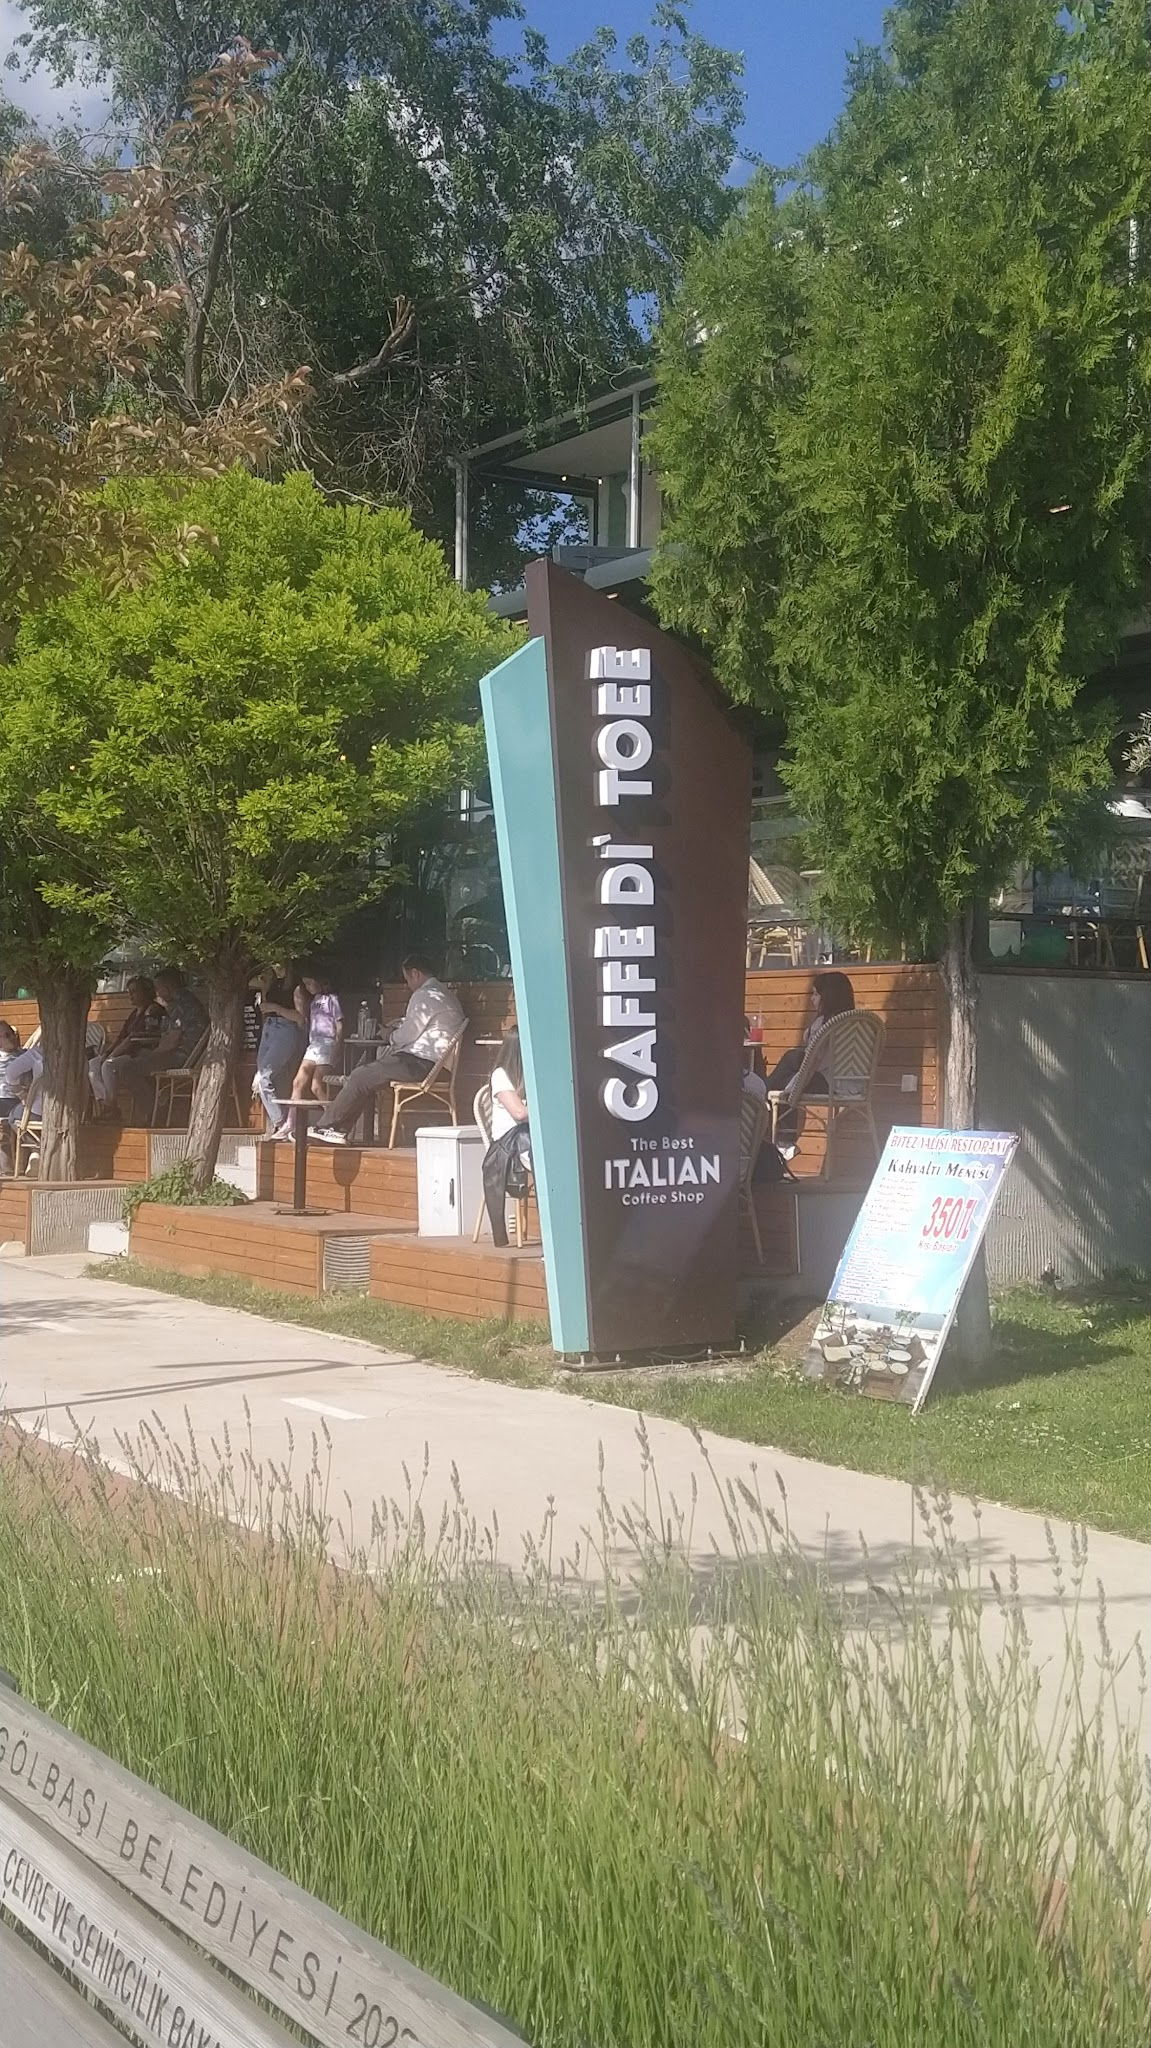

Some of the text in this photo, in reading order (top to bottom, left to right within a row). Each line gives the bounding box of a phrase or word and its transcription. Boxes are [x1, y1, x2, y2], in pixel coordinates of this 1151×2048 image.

[630, 1136, 695, 1152] The Best
[604, 1154, 721, 1190] ITALIAN
[622, 1190, 705, 1206] Coffee Shop
[120, 1818, 343, 2017] BELEDİYESİ
[2, 1848, 54, 1923] ÇEVRE
[52, 1890, 76, 1944] VE
[71, 1914, 170, 2038] ŞEHİRCİLİK
